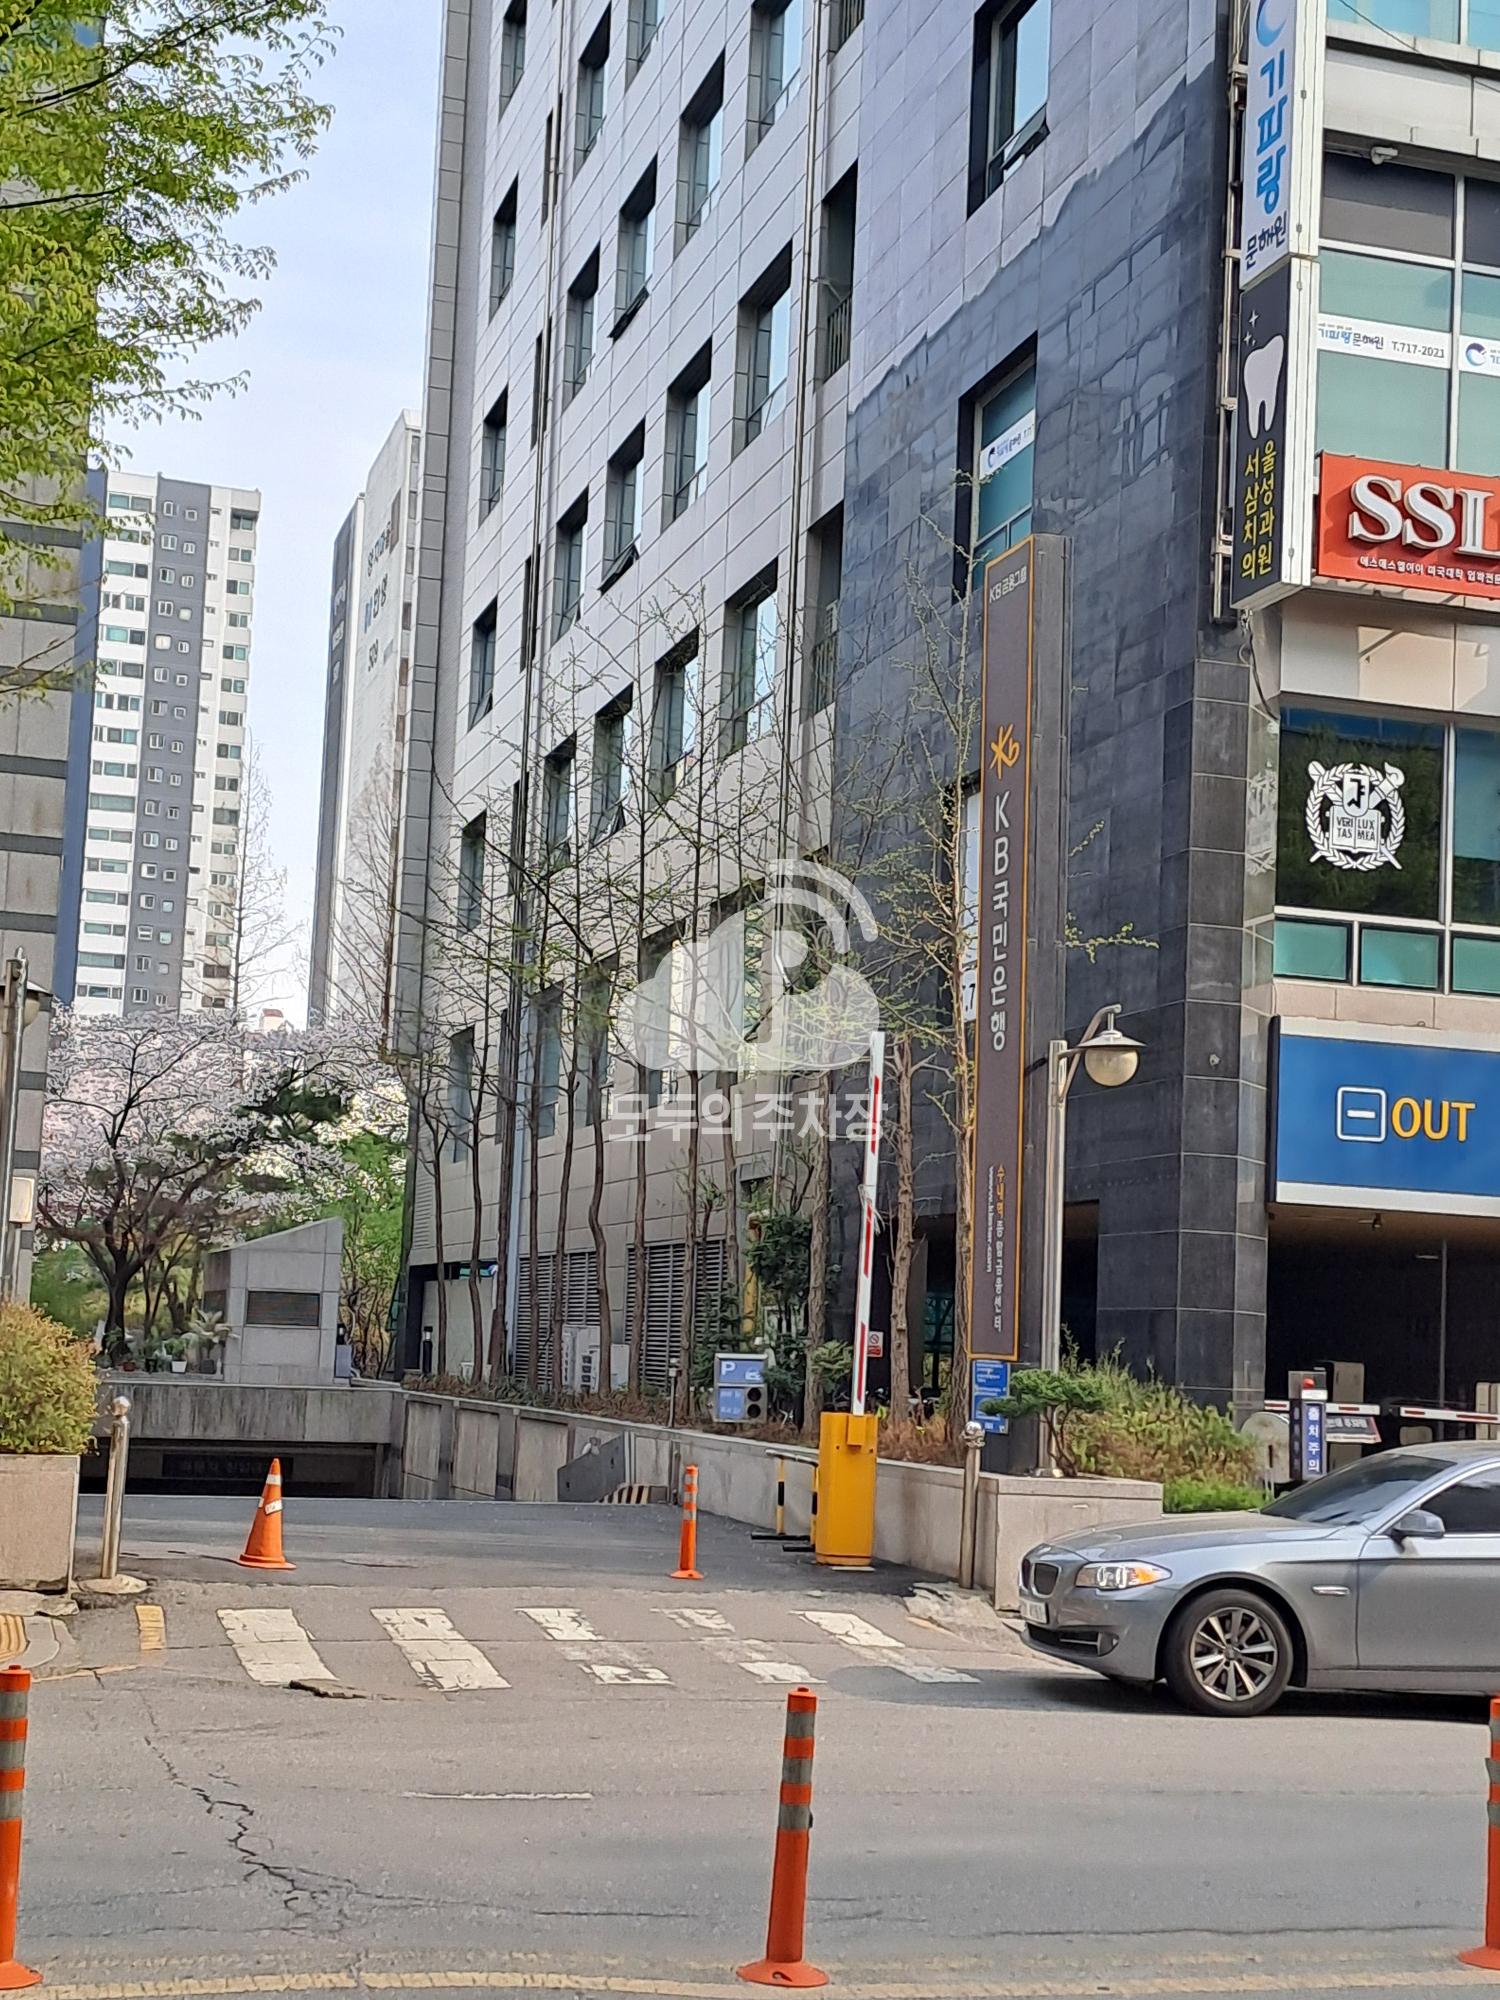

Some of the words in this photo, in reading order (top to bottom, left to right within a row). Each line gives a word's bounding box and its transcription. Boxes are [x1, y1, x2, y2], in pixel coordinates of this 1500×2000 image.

[1256, 49, 1288, 215] 기파랑
[1245, 440, 1277, 478] 서울
[1245, 472, 1275, 516] 삼성
[1243, 507, 1274, 545] 치과
[1241, 541, 1272, 580] 의원
[1357, 818, 1375, 829] LUX
[990, 790, 1010, 1052] KB국민은행
[1392, 1097, 1476, 1142] OUT
[721, 1361, 736, 1376] P
